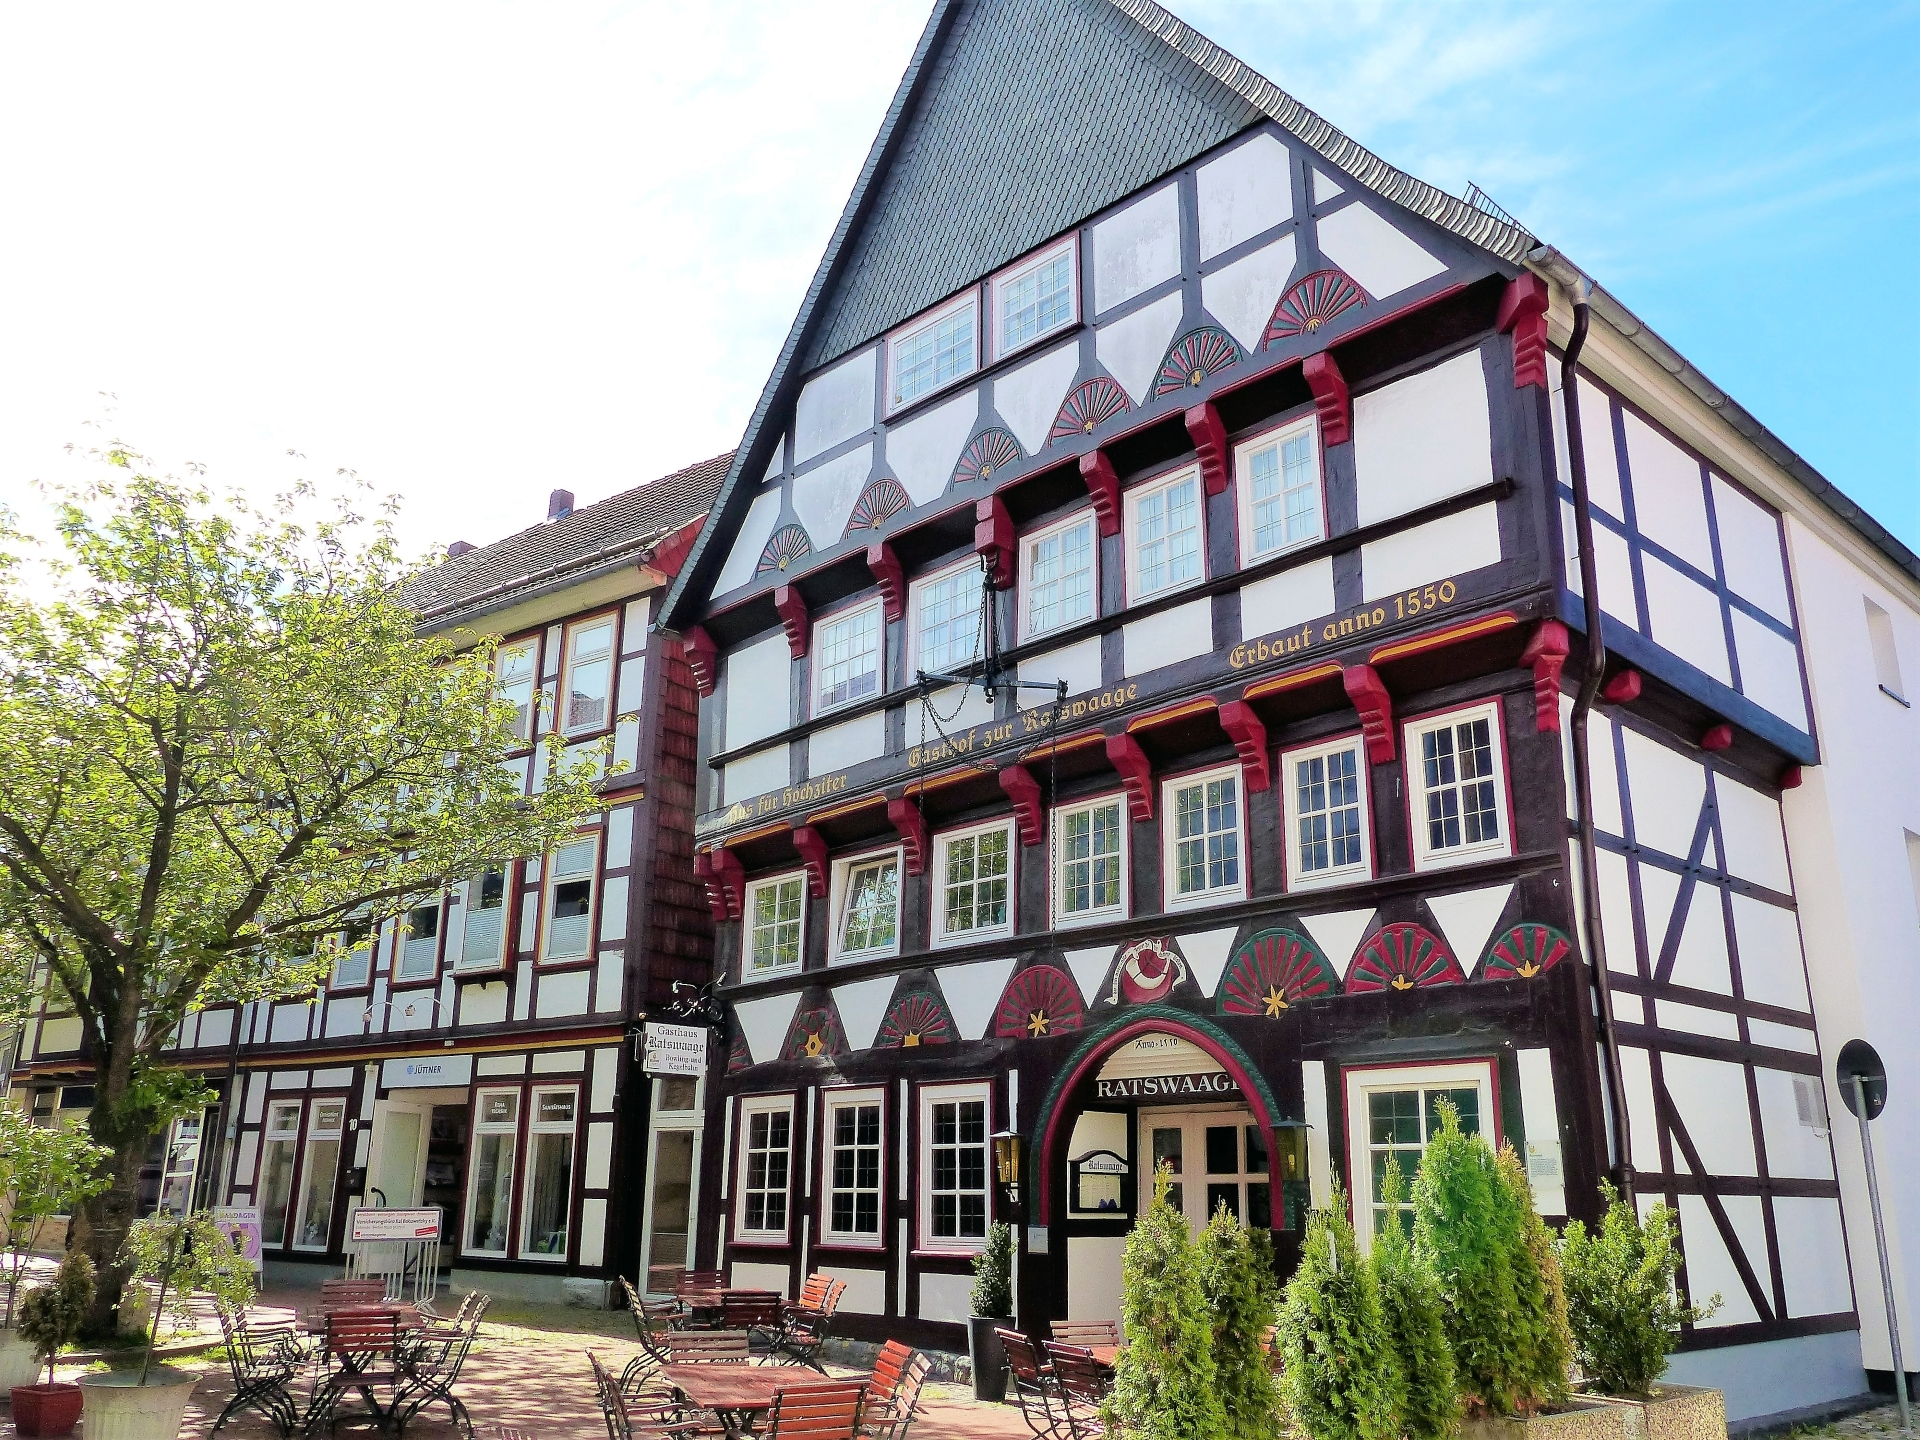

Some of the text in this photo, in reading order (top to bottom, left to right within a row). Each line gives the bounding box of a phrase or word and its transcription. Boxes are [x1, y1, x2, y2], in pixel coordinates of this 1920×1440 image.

[1229, 580, 1456, 669] Erbaut anno 1550
[984, 721, 1013, 748] zur
[1022, 683, 1138, 732] Raswaage
[758, 794, 778, 816] für
[657, 1026, 698, 1038] Gasthaus
[649, 1036, 704, 1054] Ratswaage
[668, 1063, 699, 1071] Kegelbahn
[349, 1118, 358, 1131] 10
